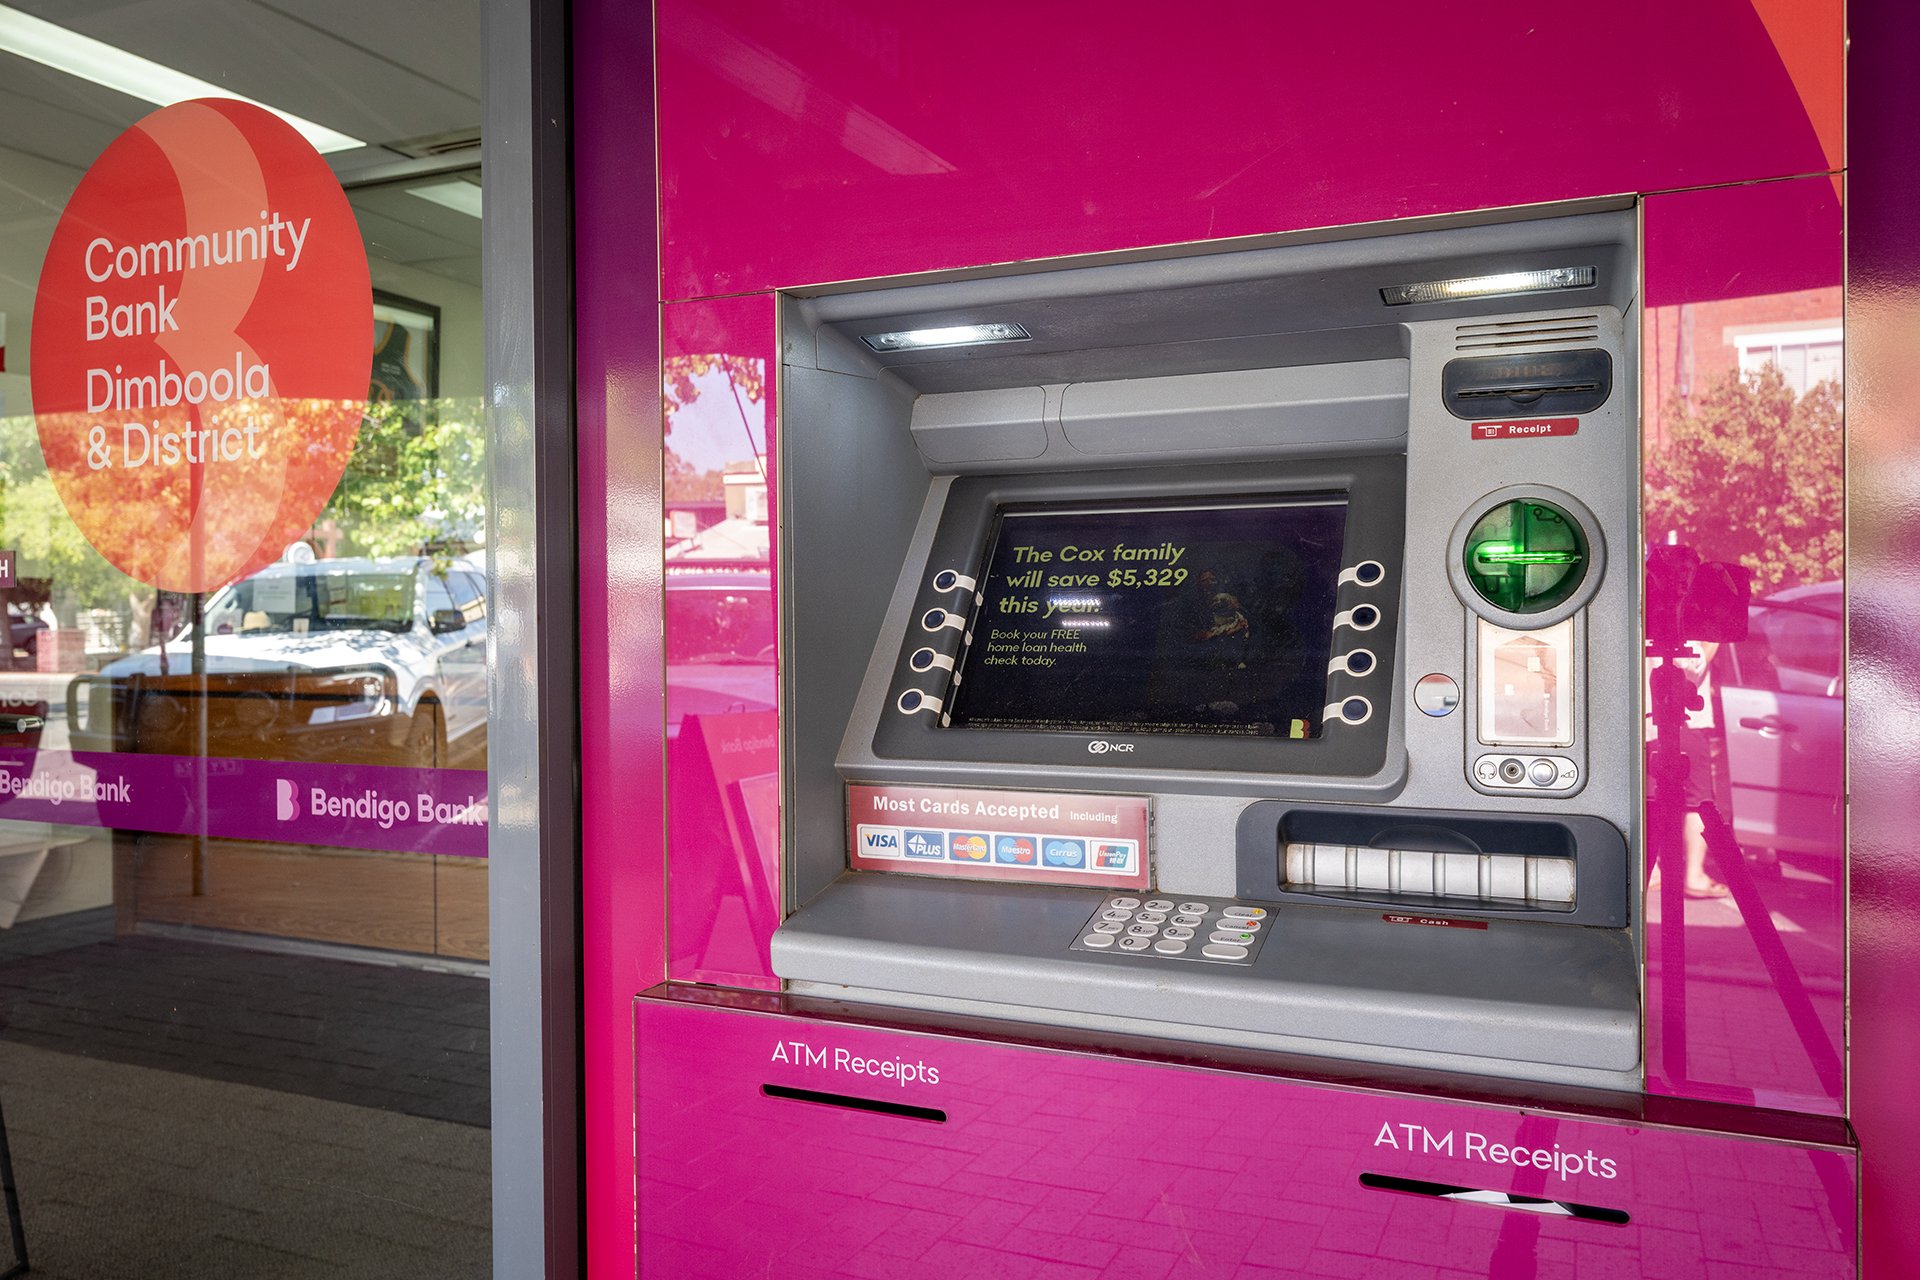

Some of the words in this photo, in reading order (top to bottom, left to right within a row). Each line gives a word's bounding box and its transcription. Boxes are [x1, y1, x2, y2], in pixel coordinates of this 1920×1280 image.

[85, 210, 311, 283] Community
[86, 285, 180, 341] Bank
[87, 352, 270, 413] Dimboola
[1509, 424, 1551, 434] Receipt
[87, 425, 112, 470] &
[124, 416, 260, 468] District
[1014, 546, 1053, 563] The
[1060, 545, 1105, 562] Cox
[1113, 542, 1185, 565] family
[1007, 570, 1043, 588] will
[1048, 574, 1100, 588] save
[1107, 568, 1189, 589] $5,329
[999, 596, 1039, 613] this
[991, 629, 1020, 640] Book
[1021, 631, 1048, 641] your
[1050, 629, 1081, 640] FREE
[987, 642, 1020, 653] home
[1021, 643, 1048, 653] loan
[1050, 642, 1087, 653] health
[984, 655, 1018, 666] check
[1021, 655, 1057, 668] today.
[1110, 743, 1134, 752] NCR
[0, 769, 74, 805] Bendigo
[80, 773, 131, 802] Bank
[311, 787, 410, 829] Bendigo
[417, 794, 484, 826] Bank
[873, 796, 915, 812] Most
[920, 798, 970, 815] Cards
[975, 800, 1060, 820] Accepted
[1070, 810, 1119, 824] Including
[865, 833, 898, 848] VISA
[916, 845, 942, 856] PLUS
[953, 843, 987, 853] MasterCard
[1001, 845, 1031, 856] Maestro
[1050, 848, 1078, 858] Cirrus
[1150, 901, 1159, 909] 2
[1107, 911, 1116, 919] 4
[1141, 913, 1150, 921] 5
[1175, 916, 1185, 924] 6
[1099, 922, 1109, 930] 7
[1132, 925, 1141, 934] 8
[1167, 928, 1178, 937] 9
[1123, 938, 1134, 946] 0
[771, 1040, 827, 1069] ATM
[835, 1047, 940, 1087] Receipts
[1373, 1121, 1454, 1157] ATM
[1465, 1131, 1617, 1181] Receipts
